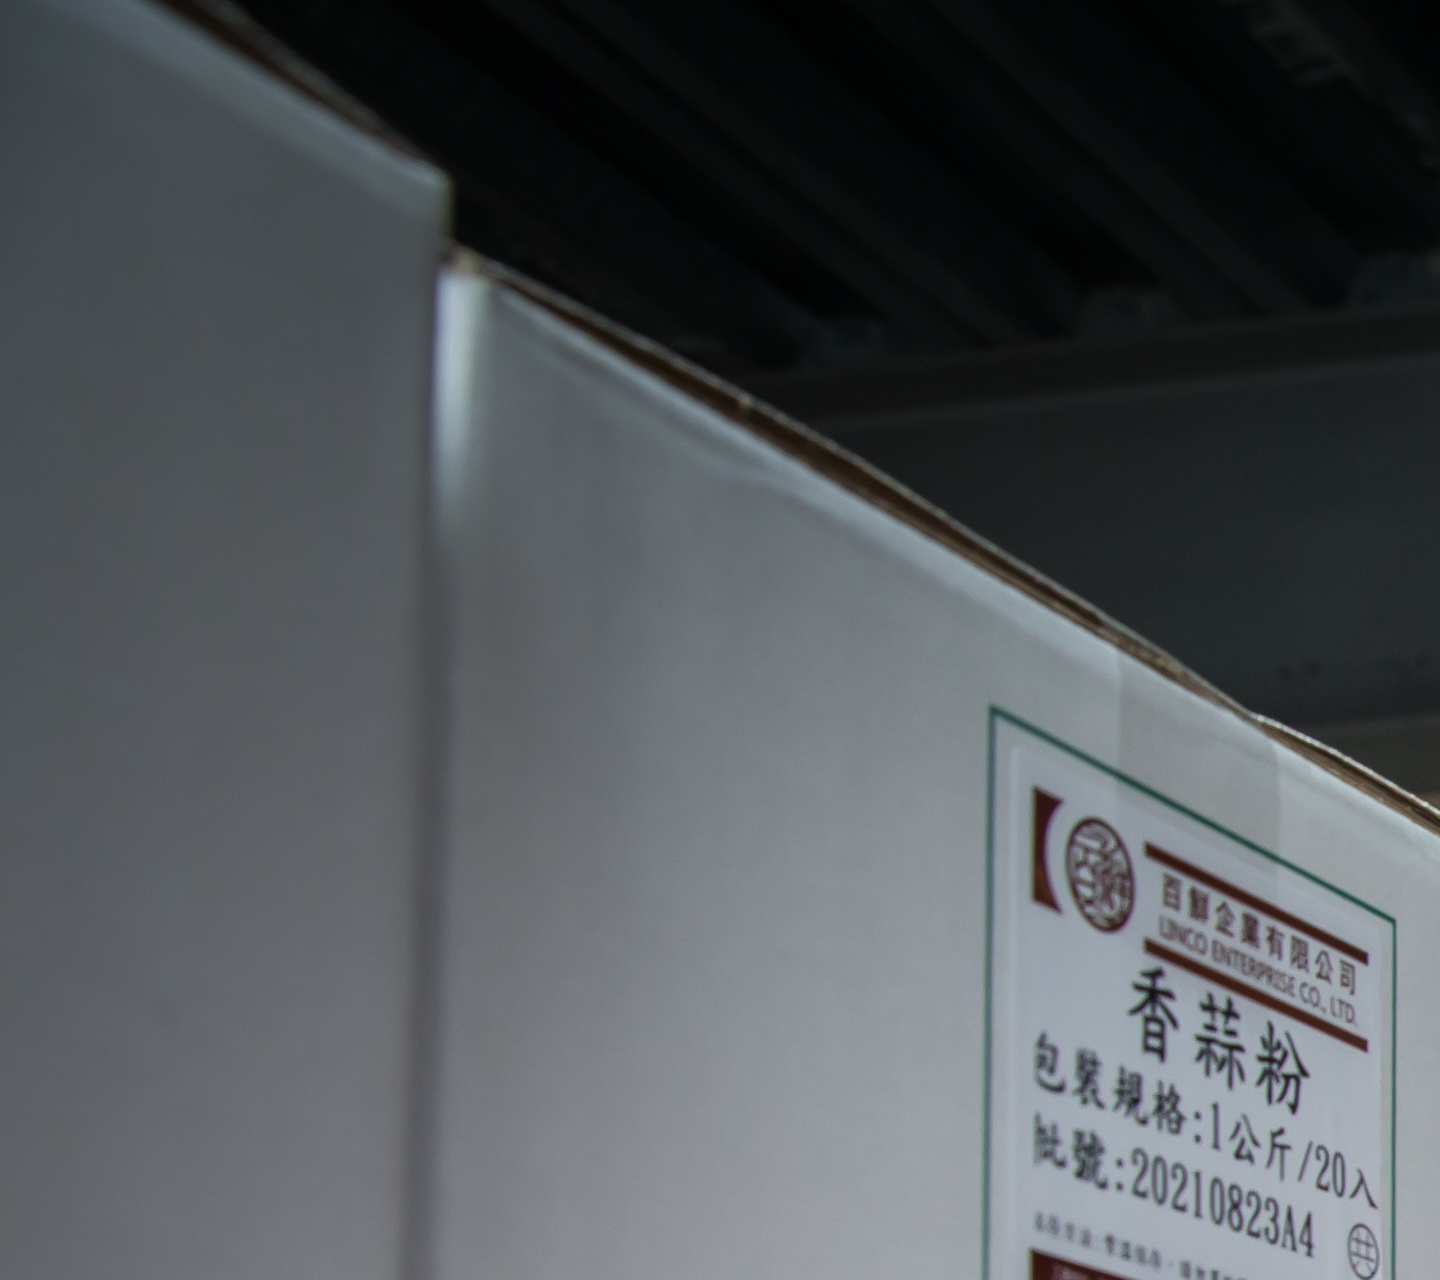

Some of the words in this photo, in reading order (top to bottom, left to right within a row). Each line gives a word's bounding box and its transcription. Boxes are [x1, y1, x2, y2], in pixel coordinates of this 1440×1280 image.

[1158, 913, 1208, 956] LINCO
[1162, 873, 1356, 996] 百鮮企業有限公司
[1128, 965, 1311, 1116] 香蒜粉
